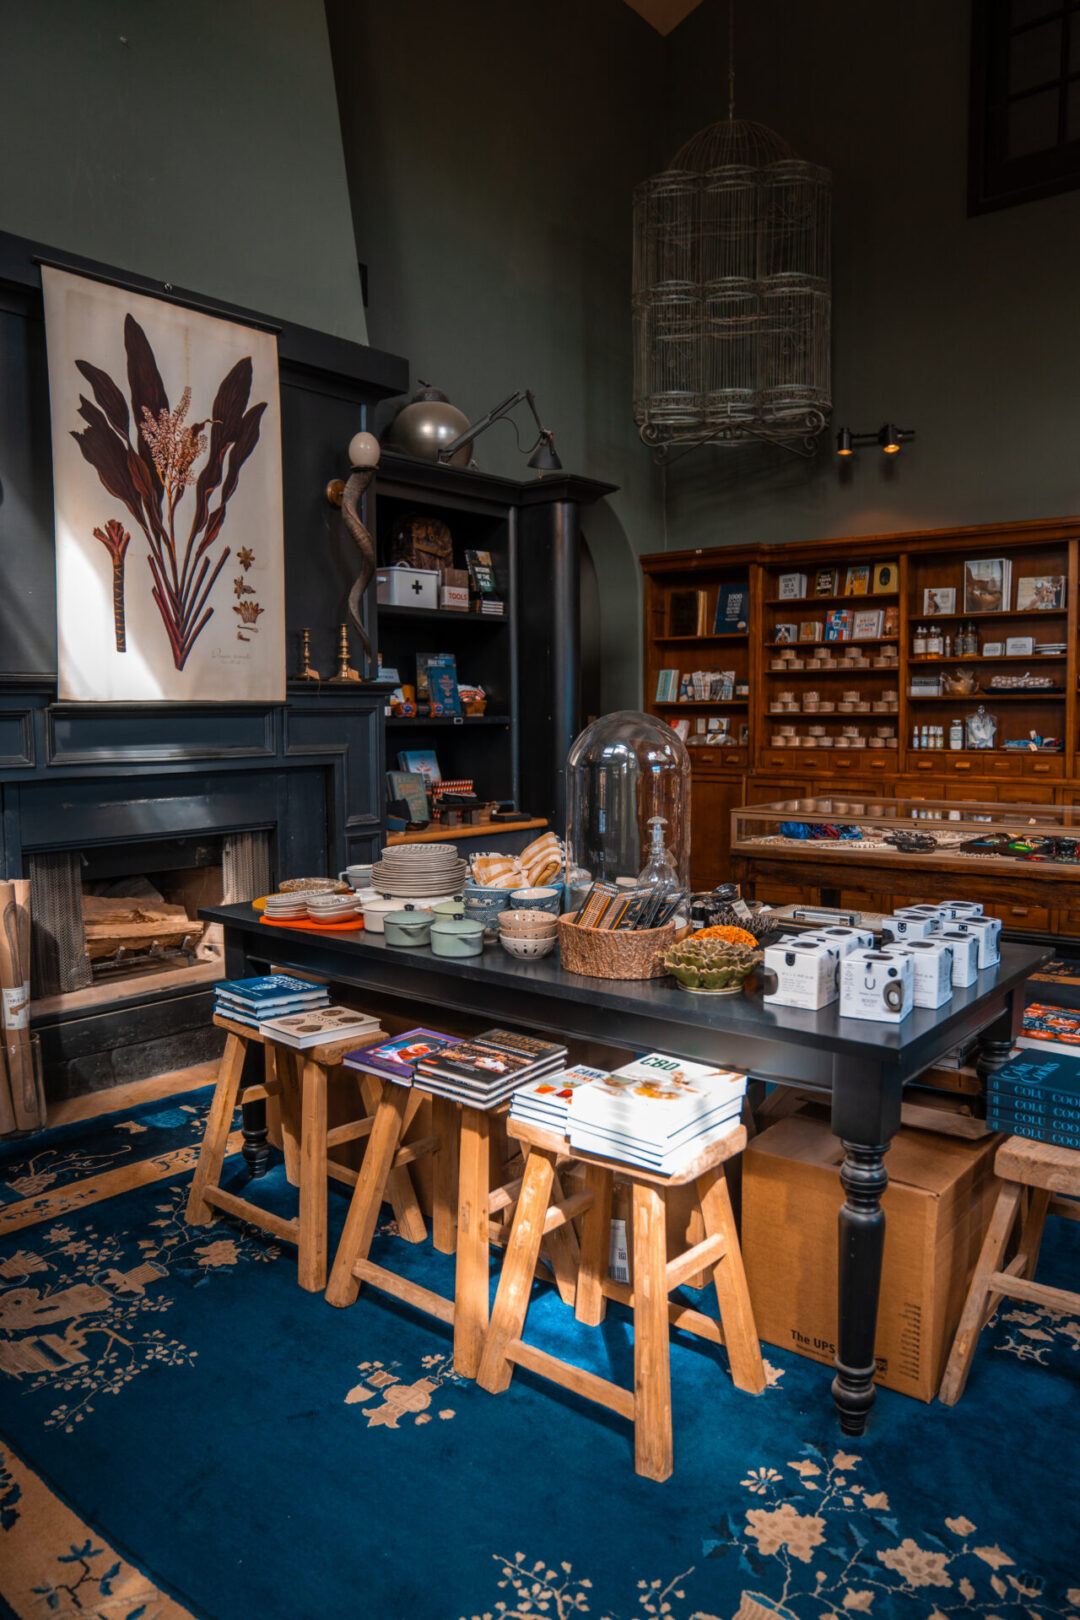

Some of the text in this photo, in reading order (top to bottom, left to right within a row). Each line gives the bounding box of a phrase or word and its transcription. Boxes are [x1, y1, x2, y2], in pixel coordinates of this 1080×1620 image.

[447, 591, 467, 601] TOOLS
[639, 1057, 681, 1071] CBD
[1052, 1094, 1080, 1108] COO
[1052, 1107, 1080, 1120] COO
[1052, 1120, 1080, 1134] COO
[1052, 1133, 1080, 1147] COO
[791, 1329, 811, 1345] The
[813, 1338, 836, 1354] UPS
